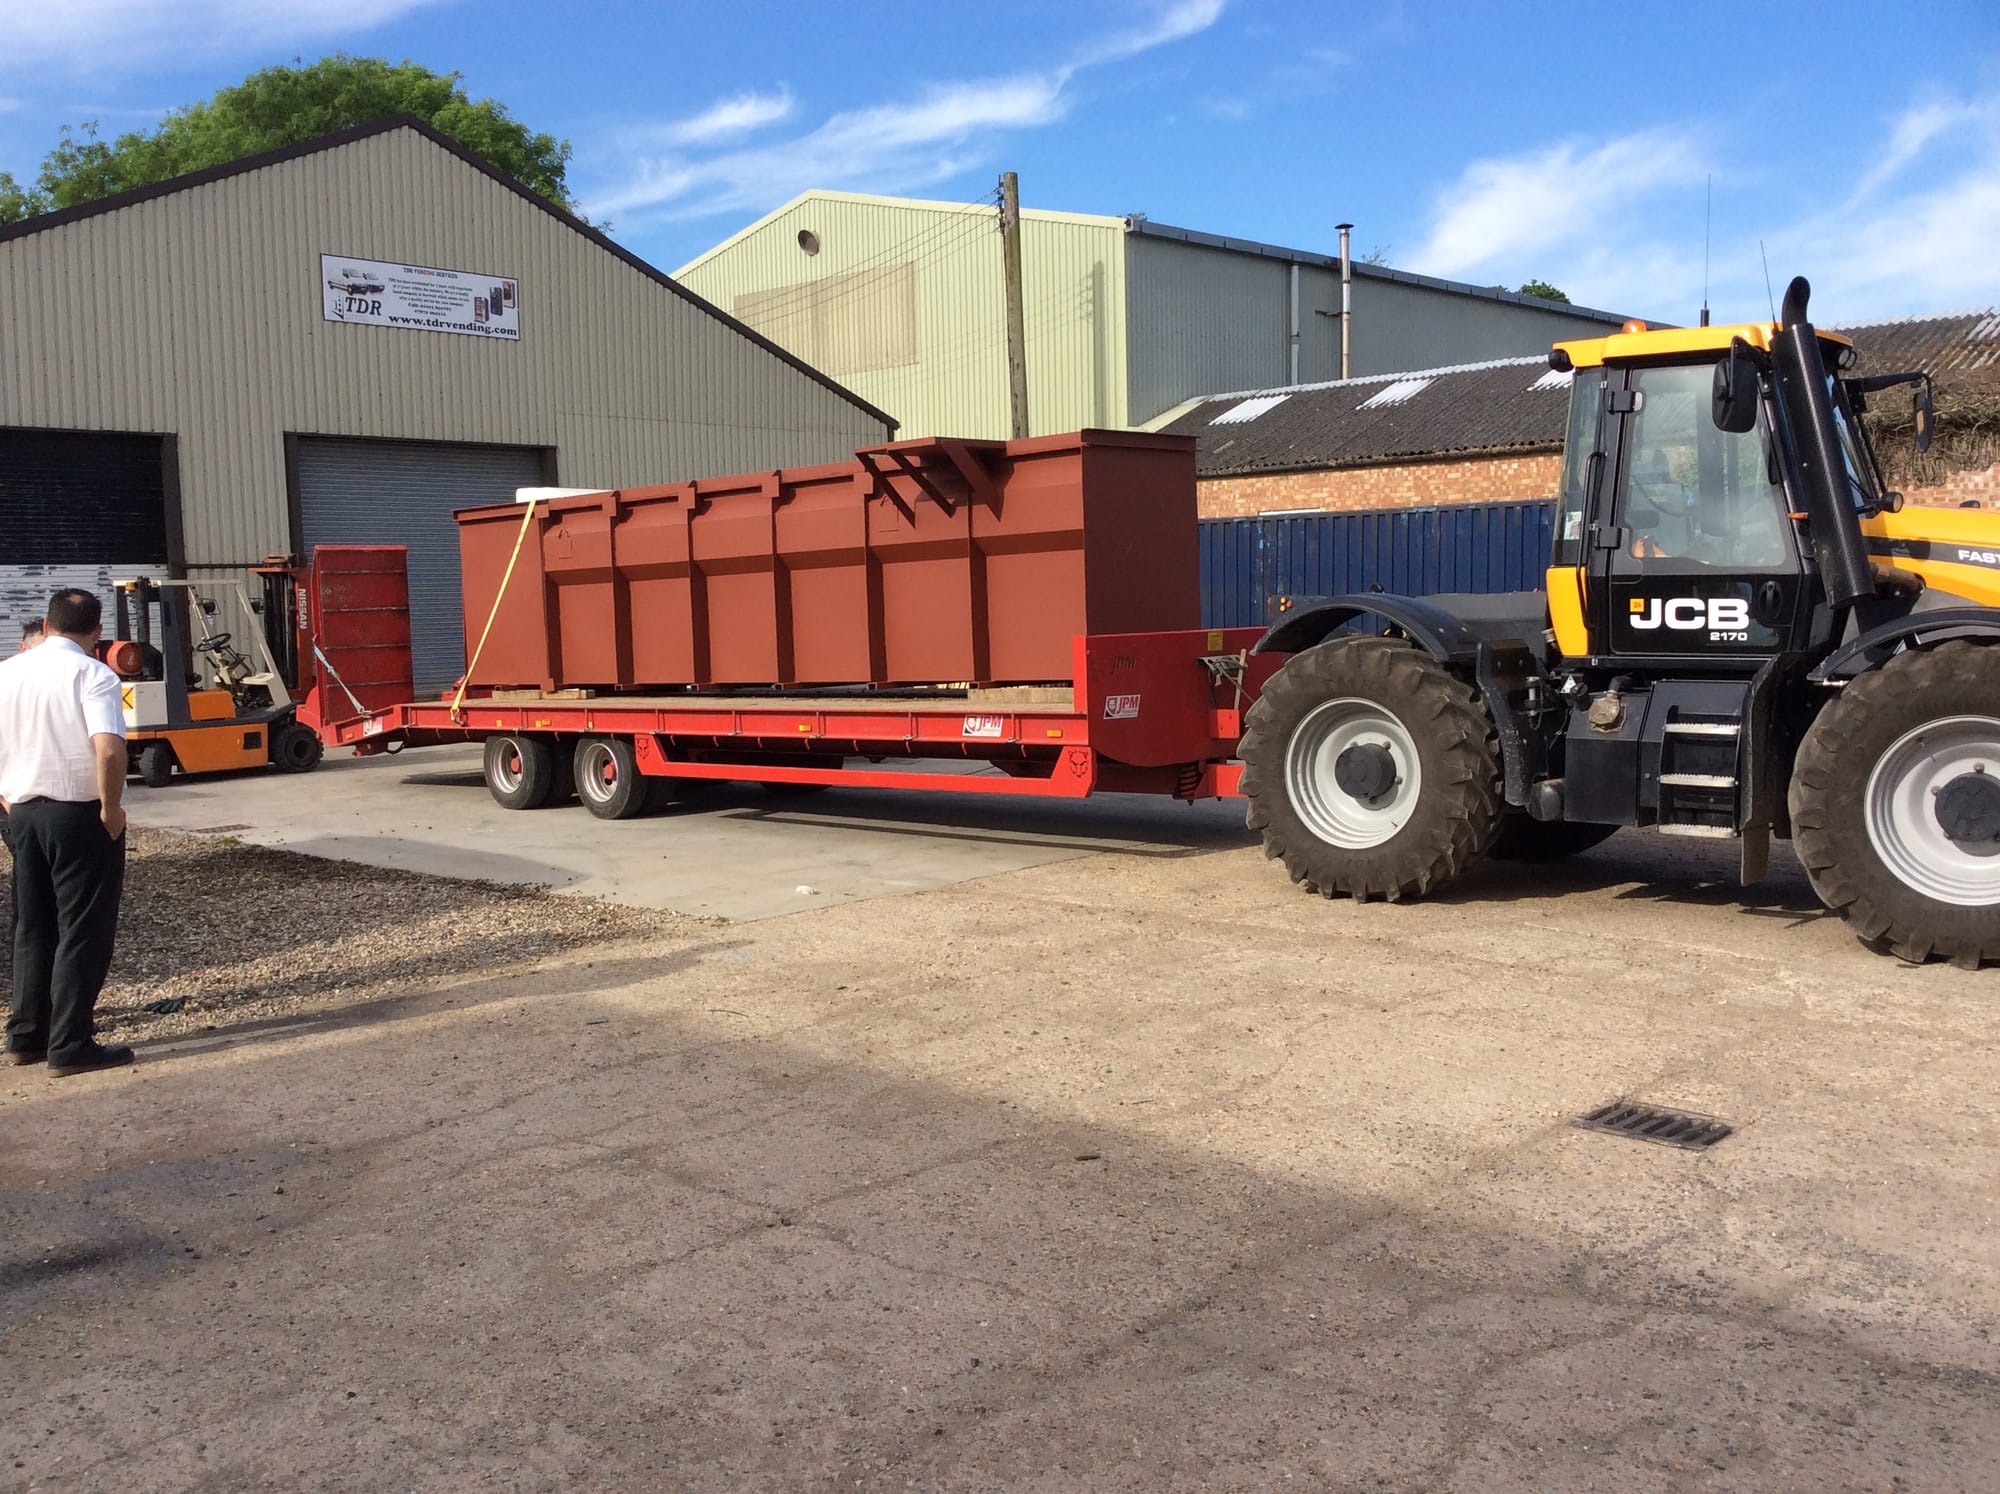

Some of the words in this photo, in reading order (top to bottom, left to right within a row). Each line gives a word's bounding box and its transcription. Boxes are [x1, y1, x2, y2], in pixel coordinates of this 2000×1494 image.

[345, 297, 382, 316] TDR
[388, 316, 517, 336] www.tdrvending.com
[299, 588, 308, 630] NISSAN
[1630, 598, 1750, 629] JCB
[1710, 632, 1748, 641] 2170
[1117, 696, 1139, 714] JPM
[977, 715, 1001, 732] JPM
